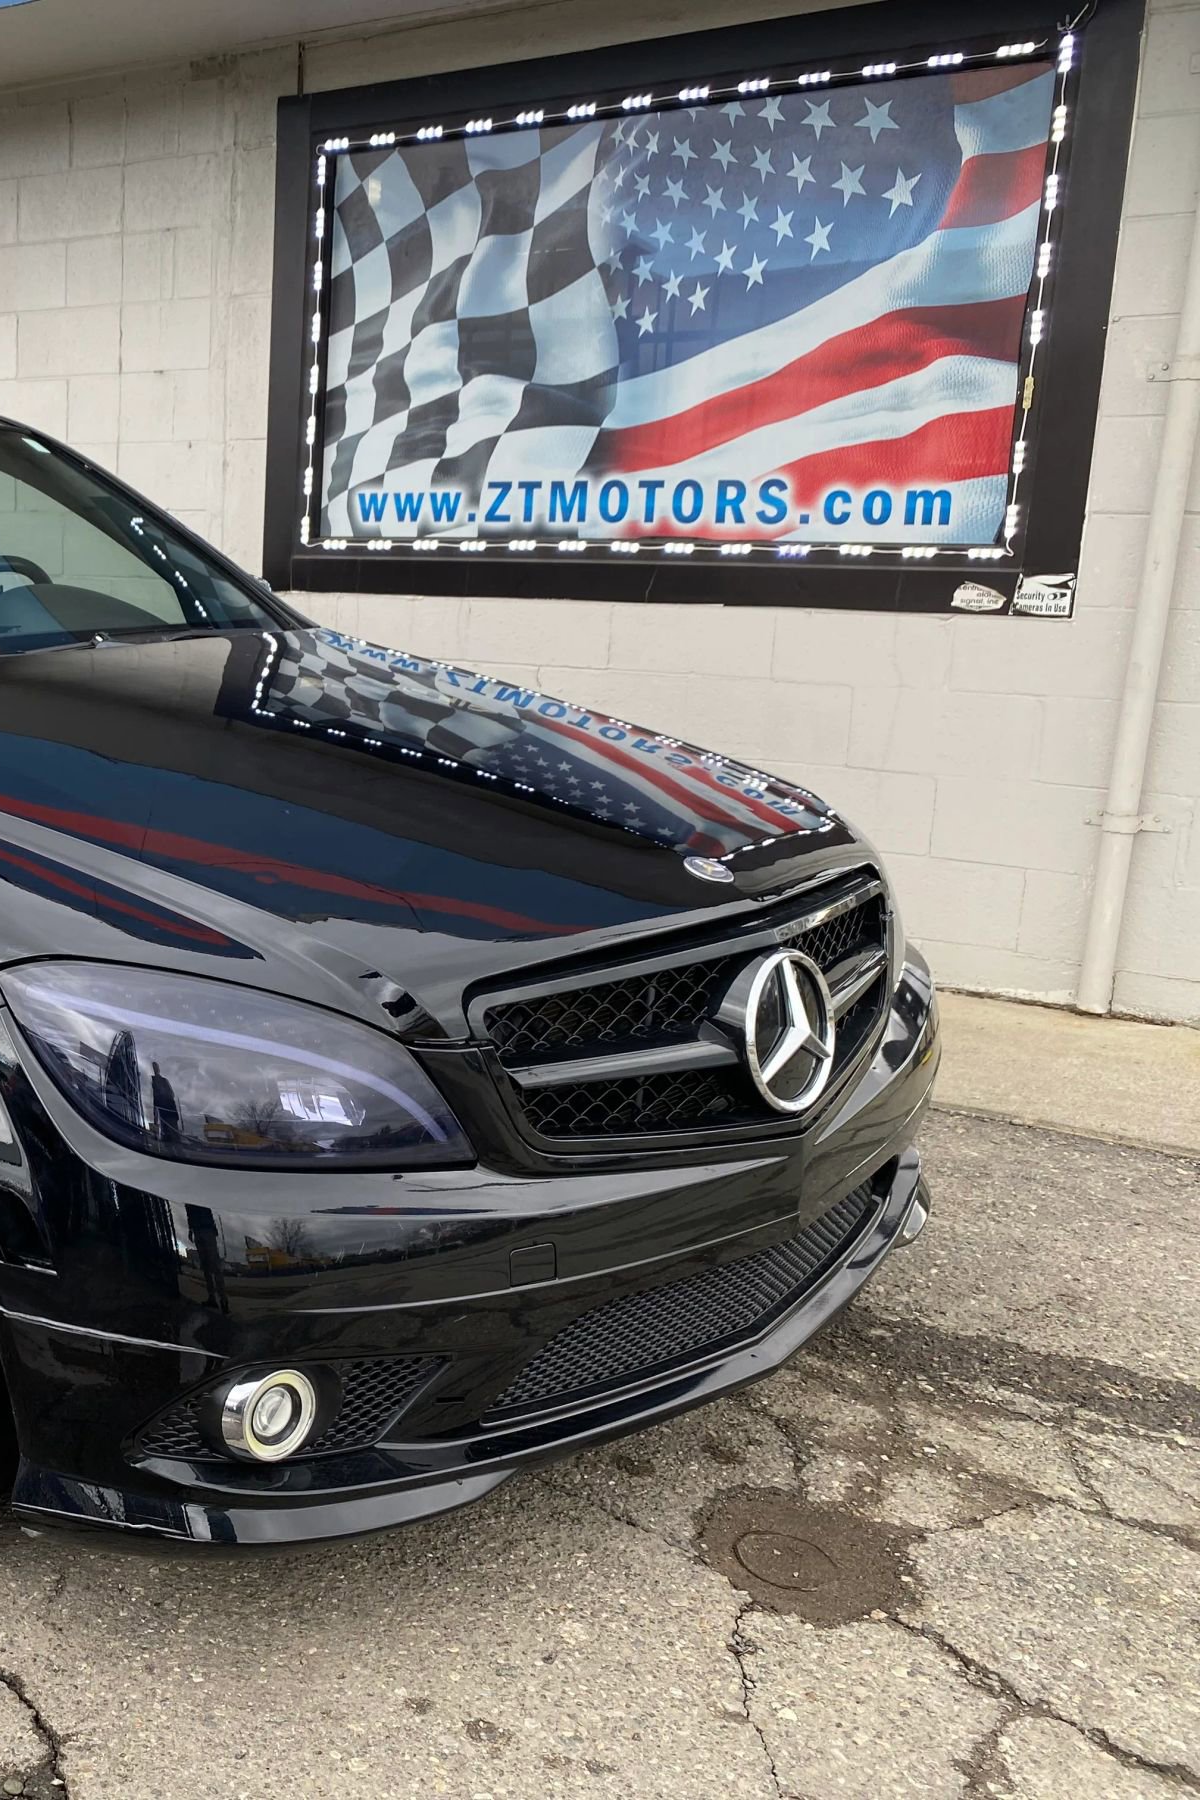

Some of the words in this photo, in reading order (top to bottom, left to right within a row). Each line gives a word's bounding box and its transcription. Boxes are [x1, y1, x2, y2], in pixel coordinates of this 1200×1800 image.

[358, 478, 952, 526] www.ZTMOTORS.com
[1016, 590, 1046, 603] Security
[1014, 602, 1044, 612] Cameras
[1045, 603, 1053, 612] In
[1054, 603, 1067, 613] Use
